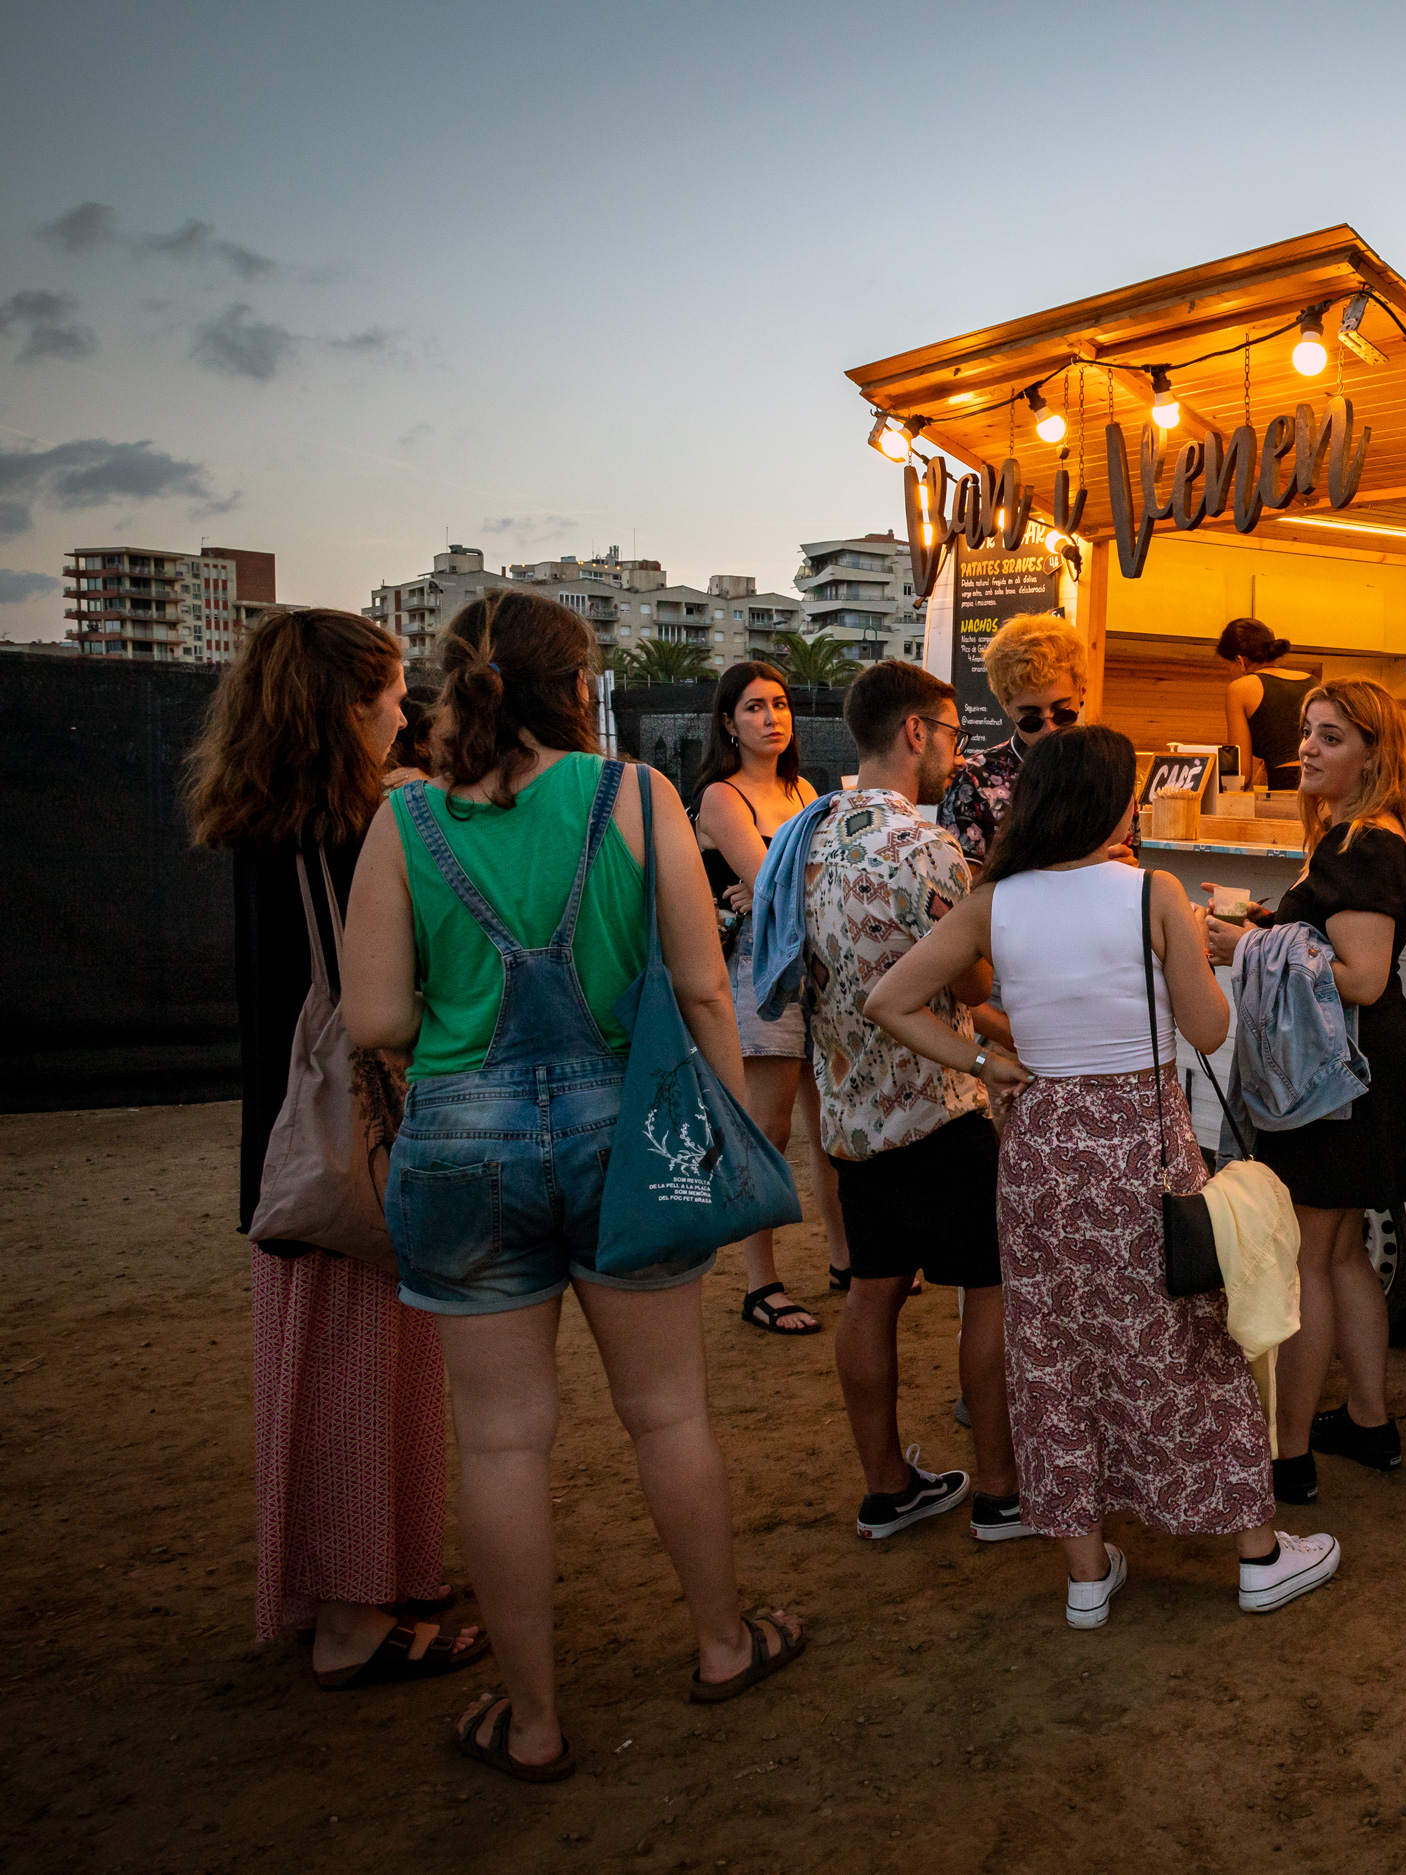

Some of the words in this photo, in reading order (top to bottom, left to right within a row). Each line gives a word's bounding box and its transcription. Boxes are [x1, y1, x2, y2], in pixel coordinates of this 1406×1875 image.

[960, 560, 1000, 577] PATATES
[1002, 557, 1044, 574] BRAVES
[960, 618, 998, 633] NACHOS
